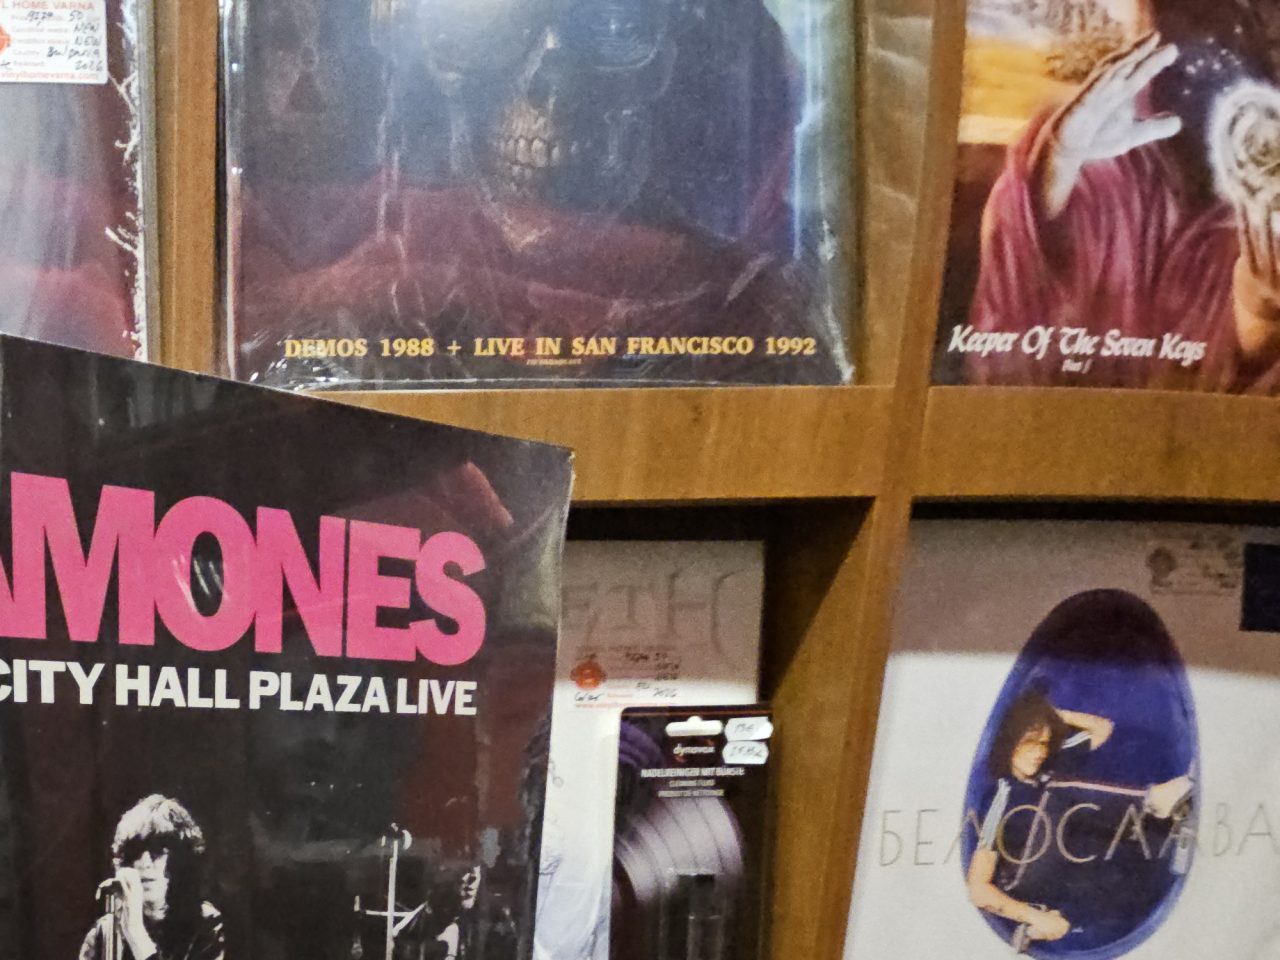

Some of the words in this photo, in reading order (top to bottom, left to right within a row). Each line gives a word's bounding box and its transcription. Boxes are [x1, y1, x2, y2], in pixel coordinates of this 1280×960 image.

[284, 337, 368, 358] DEMOS
[380, 337, 435, 358] 1988
[473, 337, 525, 357] LIVE
[535, 337, 562, 356] IN
[571, 336, 618, 356] SAN
[627, 335, 755, 356] FRANCISCO
[765, 336, 817, 356] 1992
[947, 324, 1020, 358] Keeper
[1020, 325, 1055, 361] Of
[1058, 326, 1101, 356] The
[1100, 328, 1157, 358] Seven
[1158, 332, 1208, 367] Keys
[114, 663, 241, 710] HALL
[248, 670, 391, 714] PLAZA
[395, 677, 478, 717] LIVE
